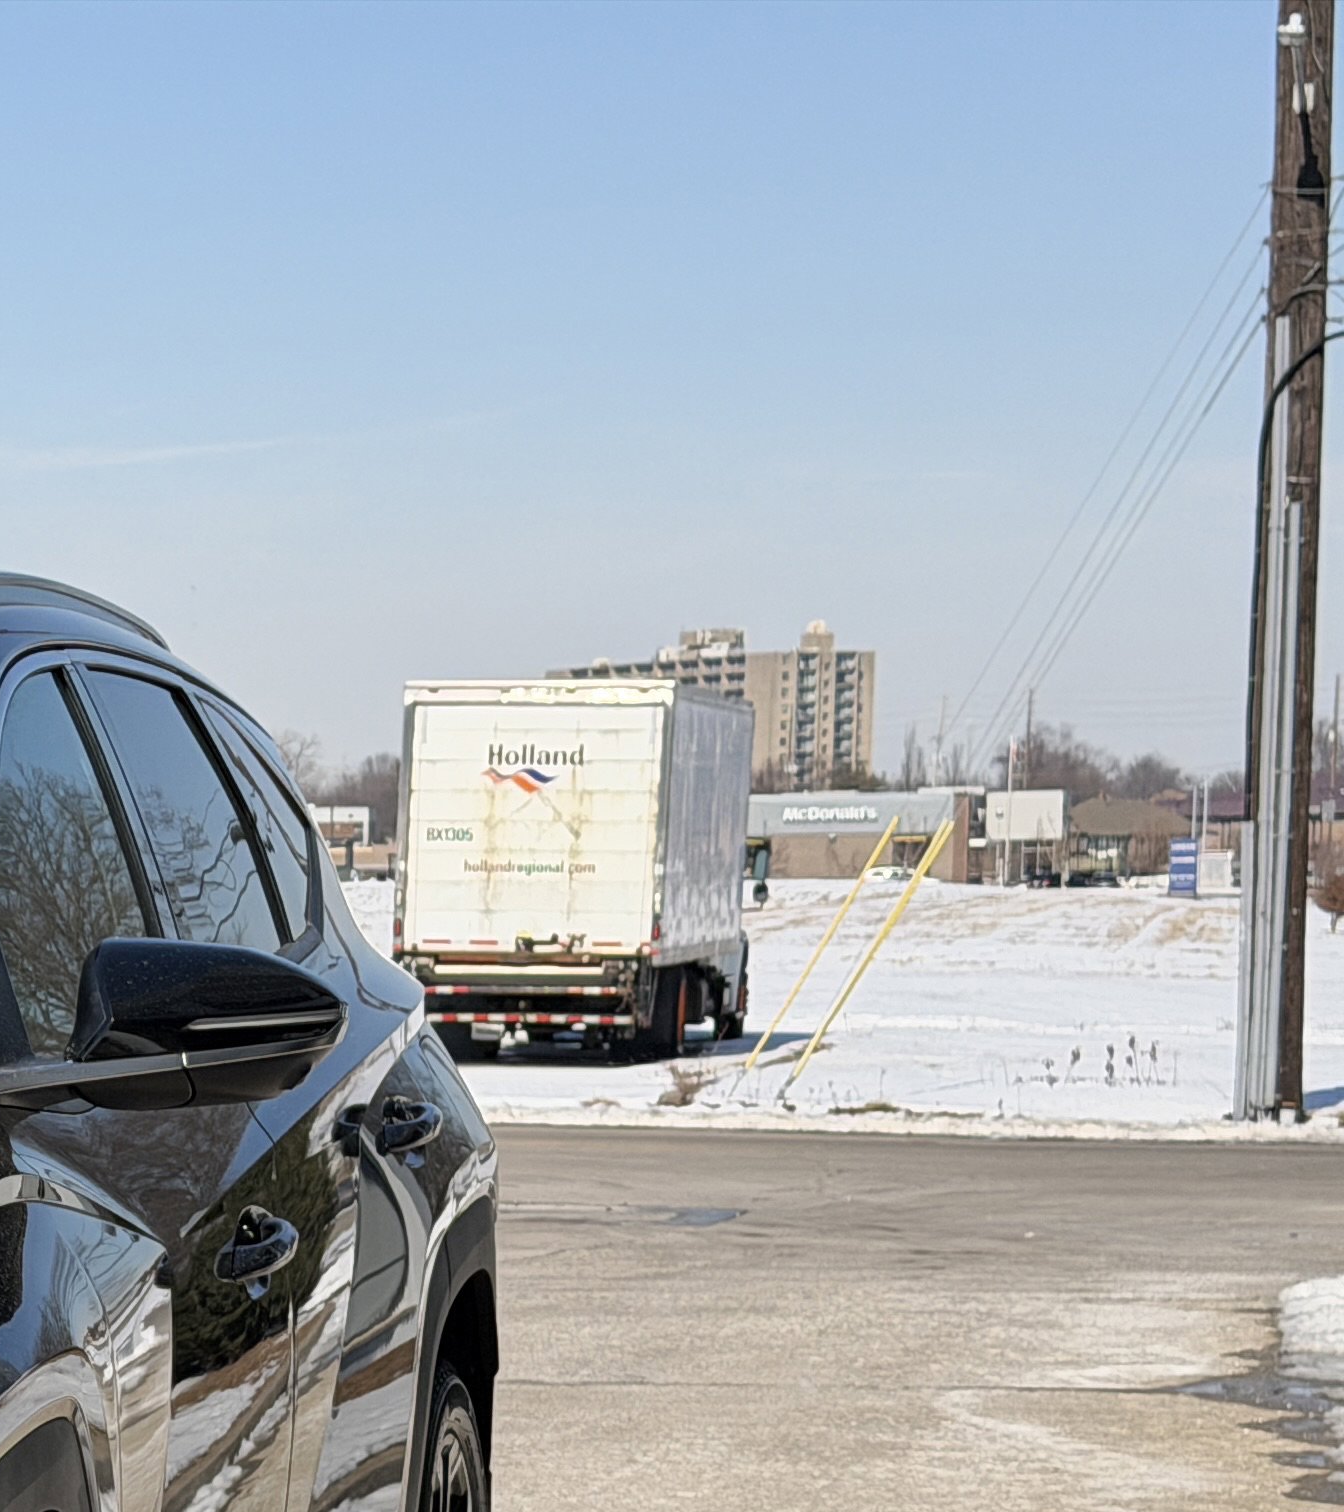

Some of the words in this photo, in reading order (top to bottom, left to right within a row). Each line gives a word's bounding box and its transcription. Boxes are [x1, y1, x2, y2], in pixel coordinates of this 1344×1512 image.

[488, 743, 584, 766] Holland
[783, 806, 877, 821] McDonald's
[464, 859, 596, 876] hollandregionalcom
